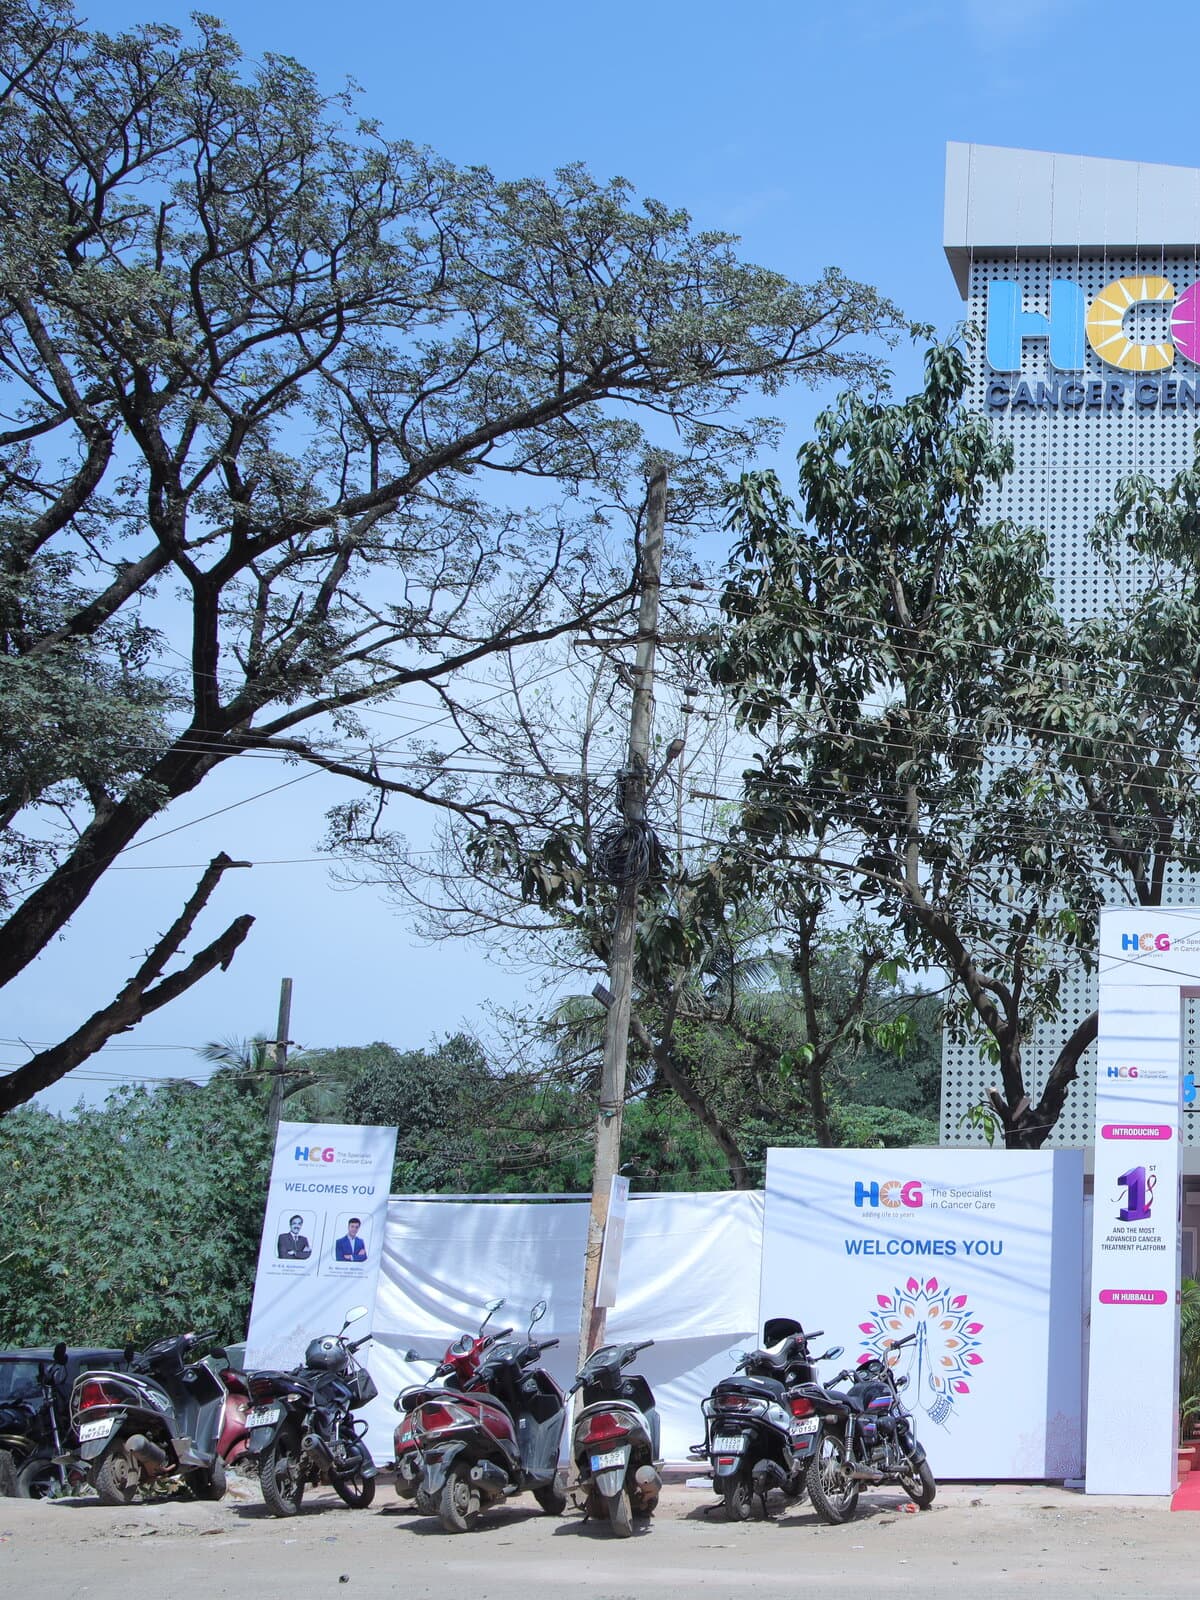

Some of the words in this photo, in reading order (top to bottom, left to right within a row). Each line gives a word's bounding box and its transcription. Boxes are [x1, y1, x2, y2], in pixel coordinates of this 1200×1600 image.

[984, 380, 1126, 406] CANCER
[1121, 933, 1171, 951] HCG
[1107, 1066, 1138, 1079] HCG
[1112, 1127, 1160, 1136] INTRODUCING
[294, 1146, 335, 1162] HCG
[285, 1183, 349, 1194] WELCOMES
[352, 1186, 375, 1195] YOU
[854, 1180, 923, 1208] HCG
[931, 1188, 947, 1198] The
[950, 1188, 992, 1199] Specialist
[930, 1200, 938, 1209] in
[940, 1201, 972, 1209] Cancer
[975, 1201, 996, 1209] Care
[845, 1239, 956, 1255] WELCOMES
[963, 1240, 1003, 1255] YOU
[1121, 1293, 1154, 1301] HUBBALLI
